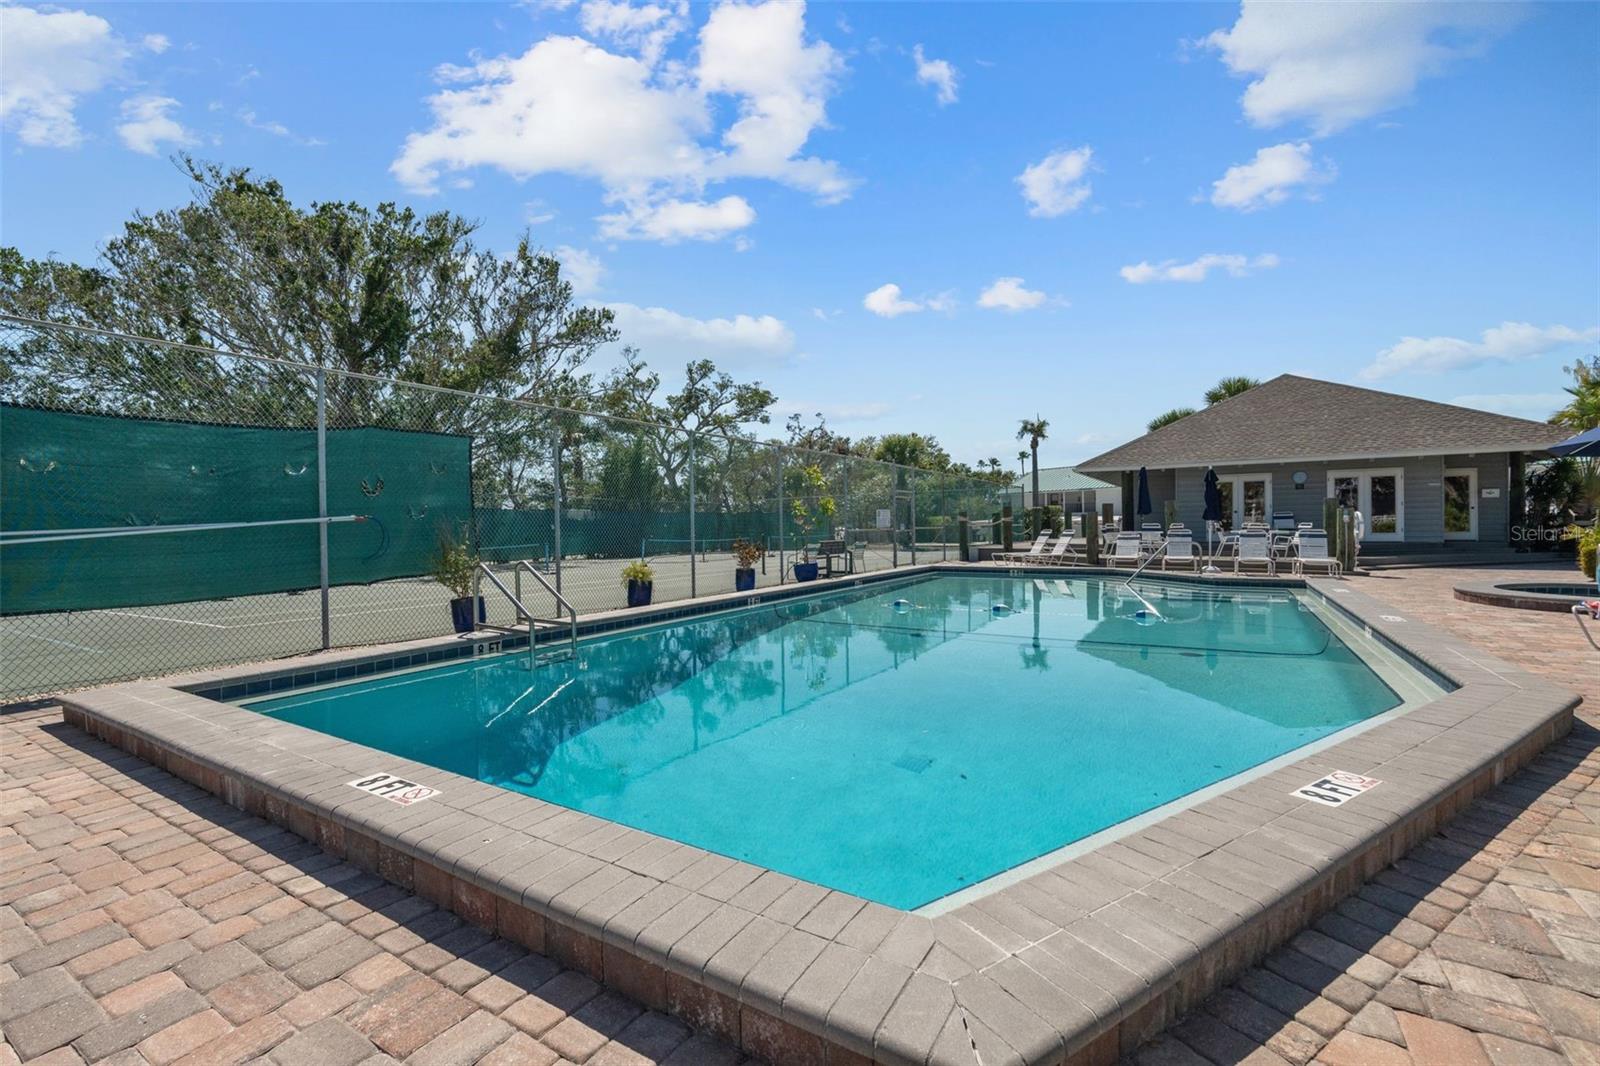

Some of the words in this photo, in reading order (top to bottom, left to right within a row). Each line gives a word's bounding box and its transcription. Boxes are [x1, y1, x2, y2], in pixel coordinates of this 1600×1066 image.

[488, 641, 501, 653] FT
[356, 775, 391, 787] 8
[369, 780, 418, 796] FT
[1311, 779, 1362, 797] FT
[1299, 789, 1342, 803] 8
